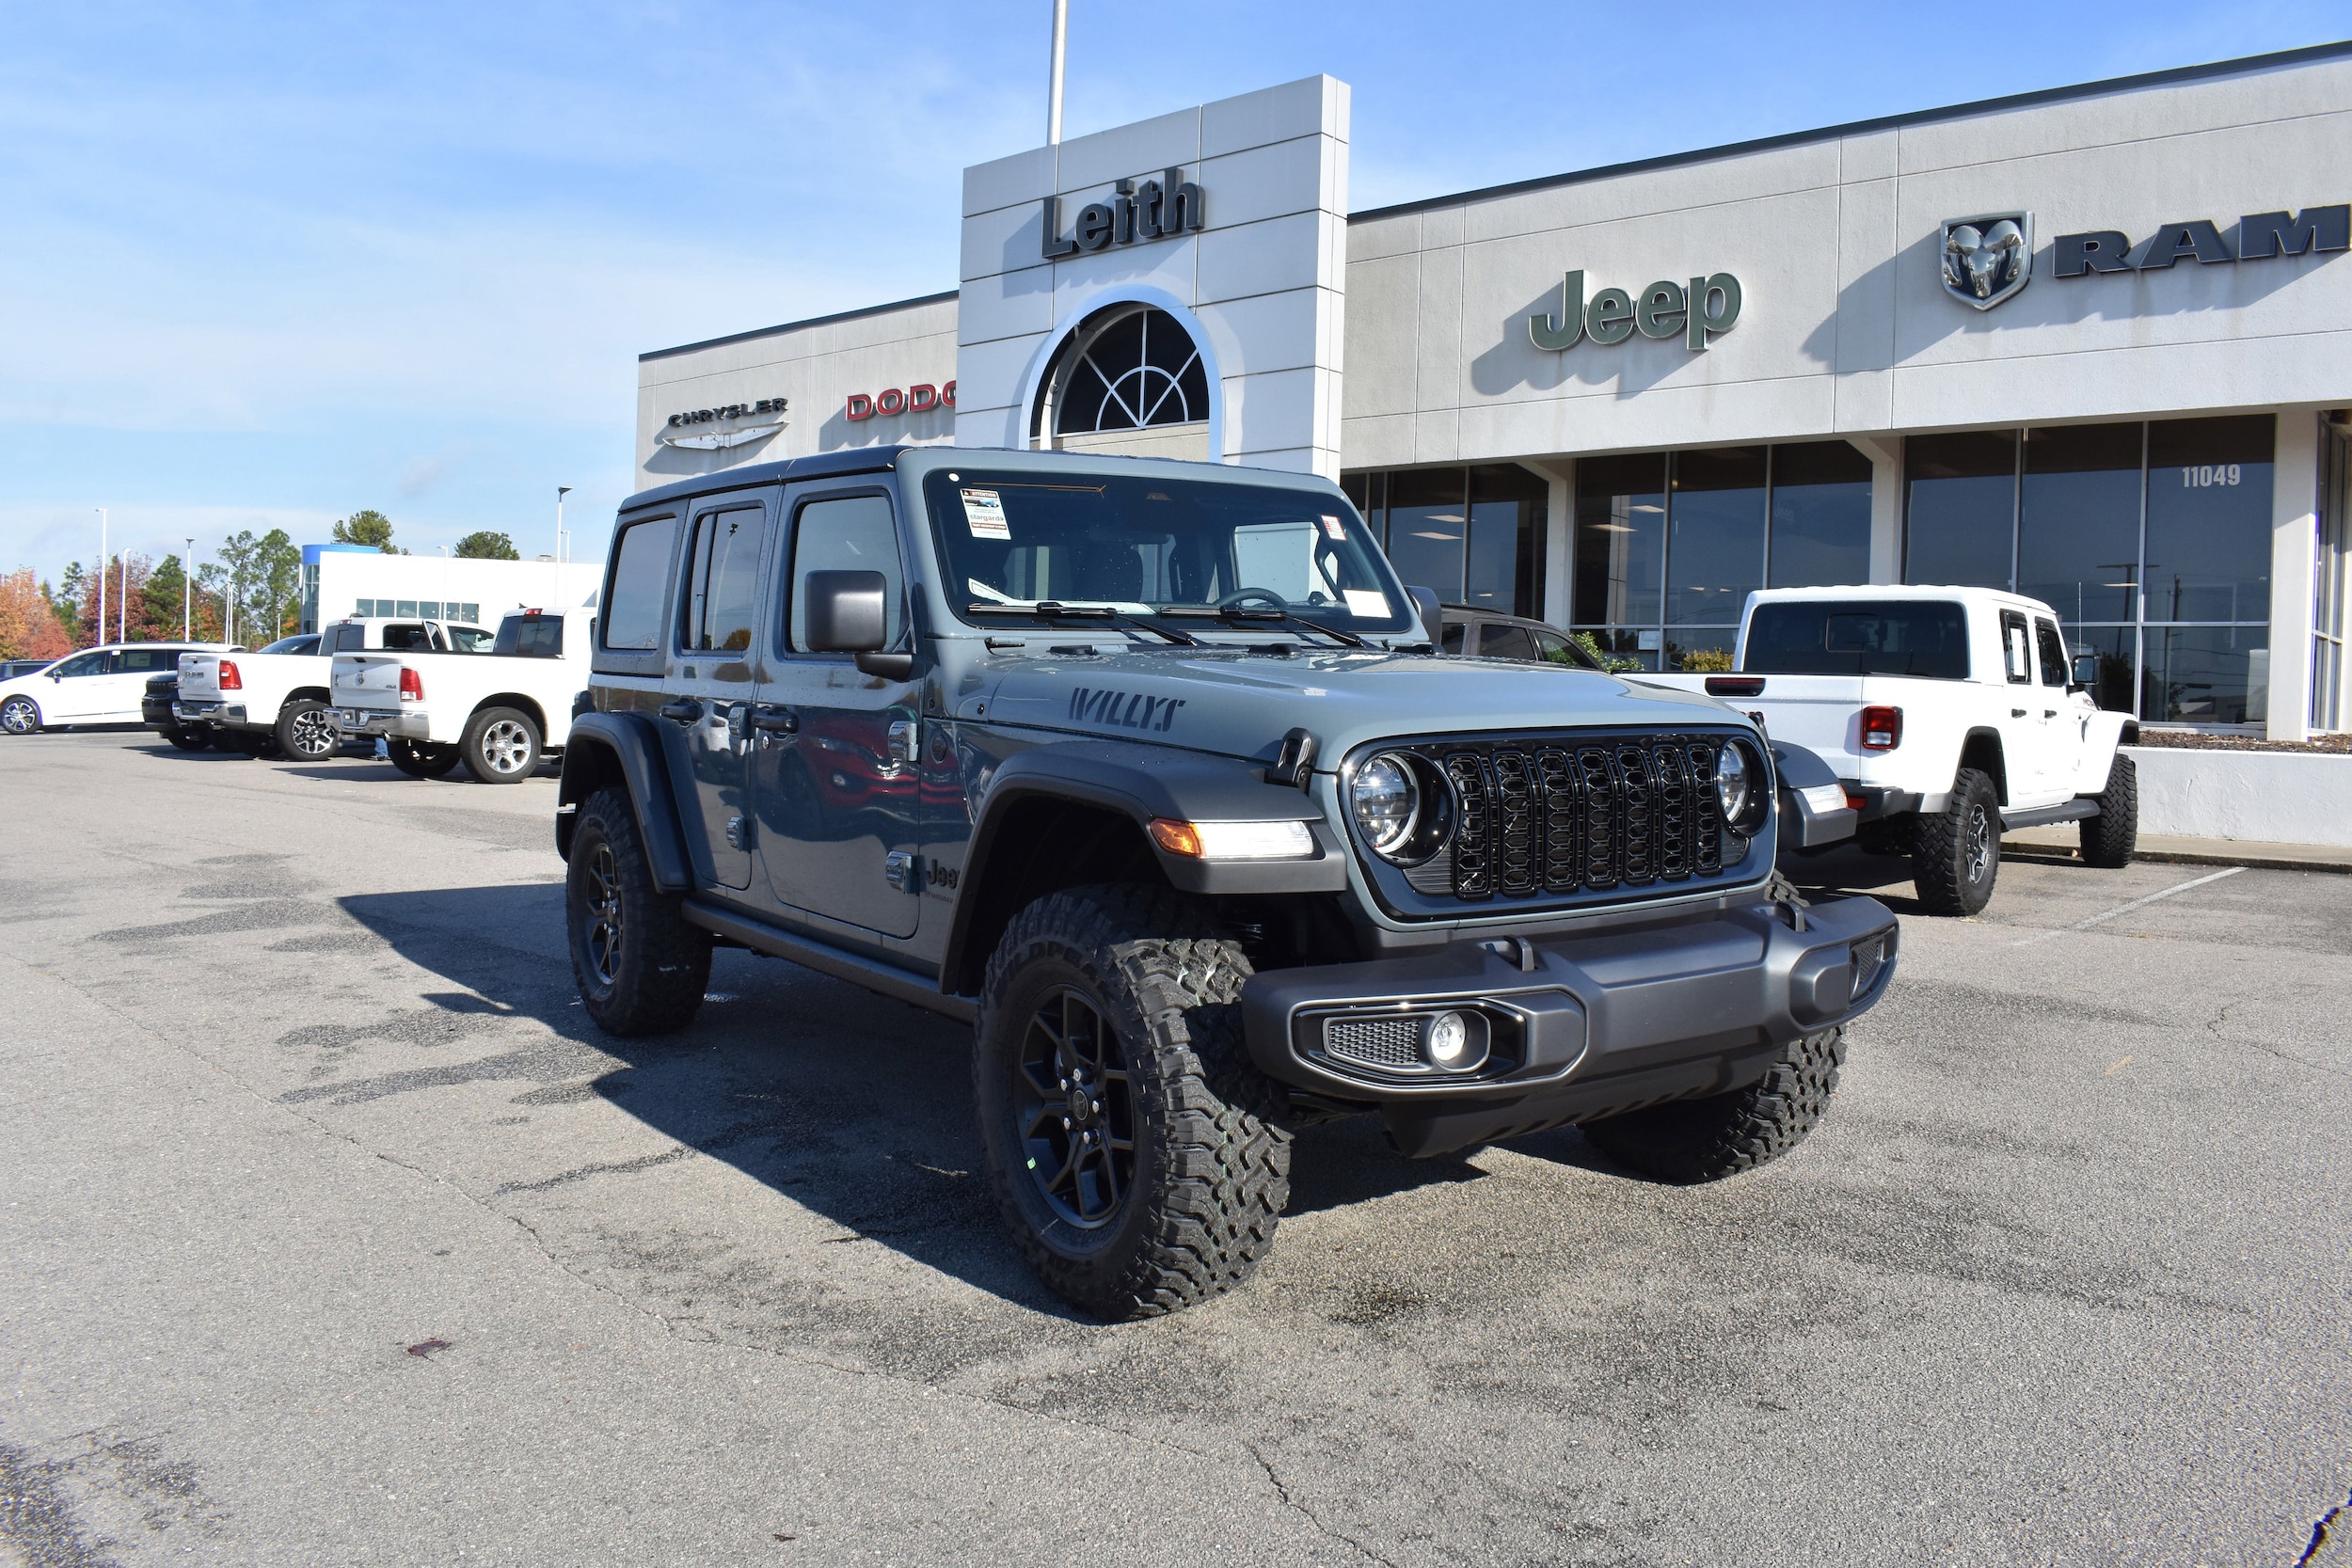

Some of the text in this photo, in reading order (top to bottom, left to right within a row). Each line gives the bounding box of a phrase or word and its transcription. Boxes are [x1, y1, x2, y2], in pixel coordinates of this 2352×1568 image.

[1041, 167, 1206, 260] Leith
[2053, 204, 2351, 277] RAM
[1529, 270, 1746, 352] Jeep
[668, 397, 788, 428] CHRYSLER
[2182, 464, 2241, 488] 11049
[1069, 687, 1187, 732] WILLYS
